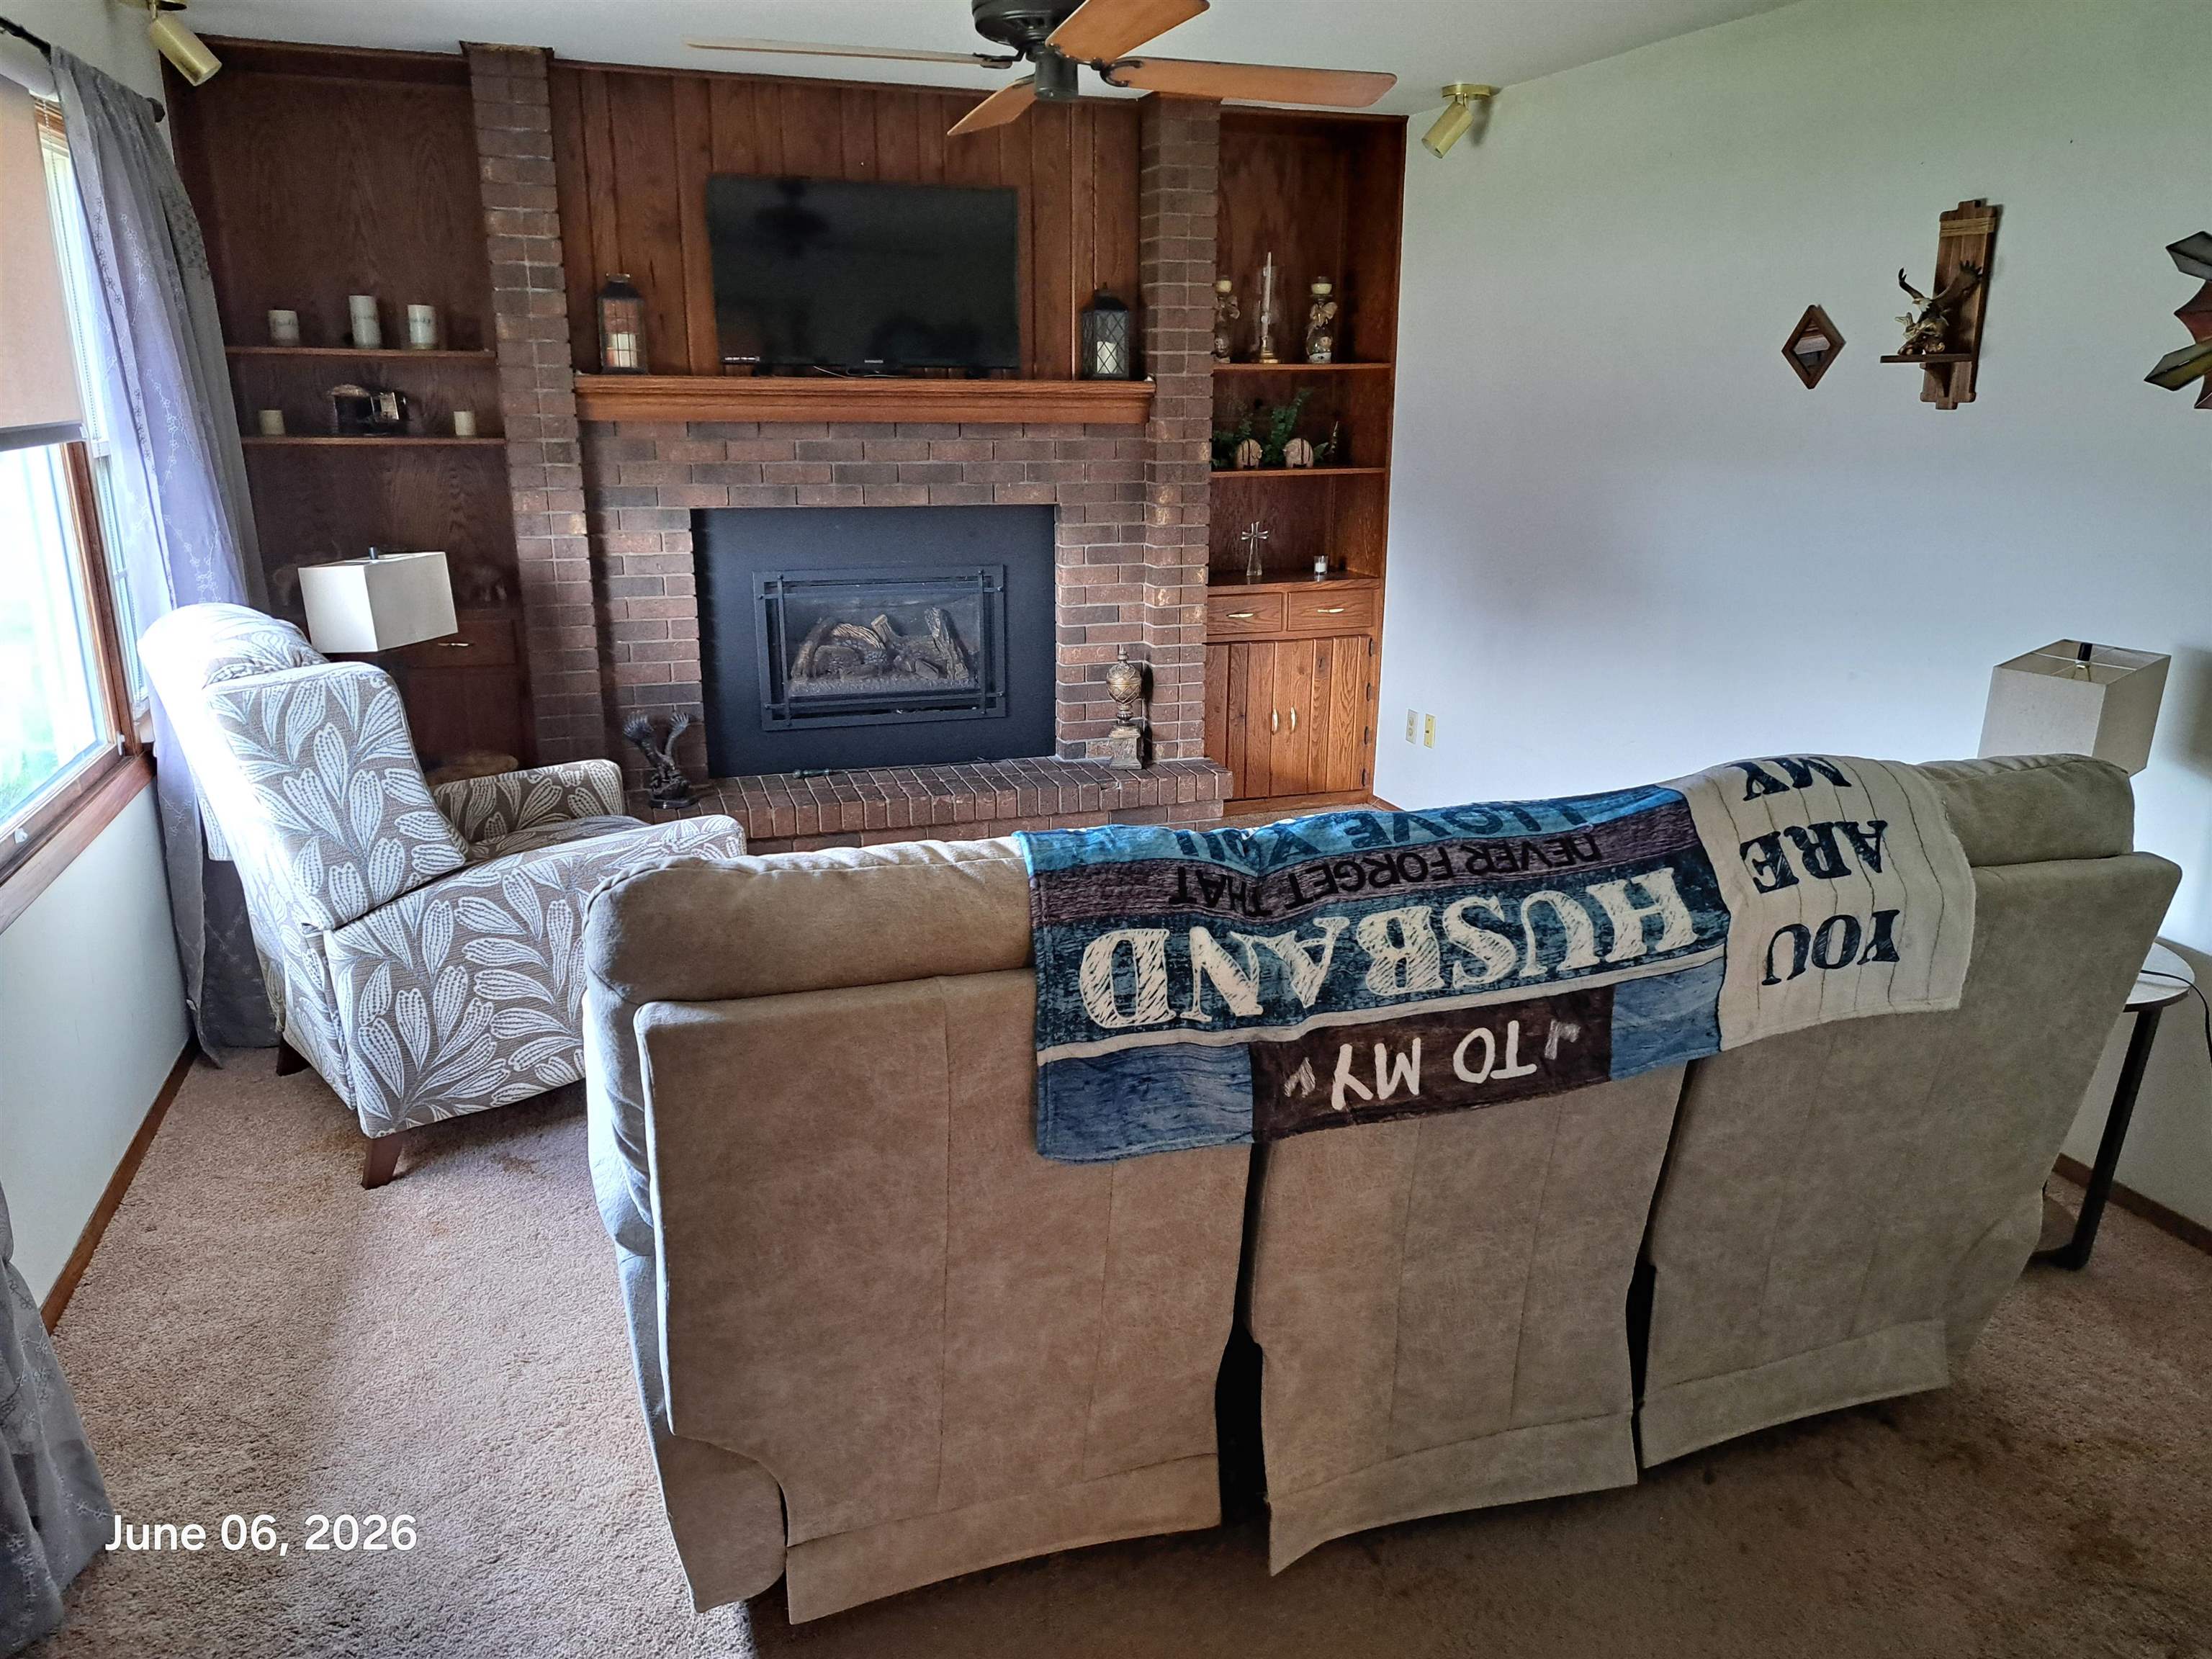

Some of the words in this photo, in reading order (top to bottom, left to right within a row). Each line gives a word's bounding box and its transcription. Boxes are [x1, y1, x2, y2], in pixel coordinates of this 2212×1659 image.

[1725, 756, 1852, 801] MY
[1284, 847, 1455, 911] FORGET
[1460, 832, 1603, 877] NEVER
[1740, 820, 1888, 894] ARE
[1168, 867, 1272, 917] THAT
[1079, 867, 1699, 1029] HUSBAND
[1761, 909, 1900, 986] YOU
[1331, 1038, 1421, 1110] MY
[1454, 1020, 1537, 1084] TO
